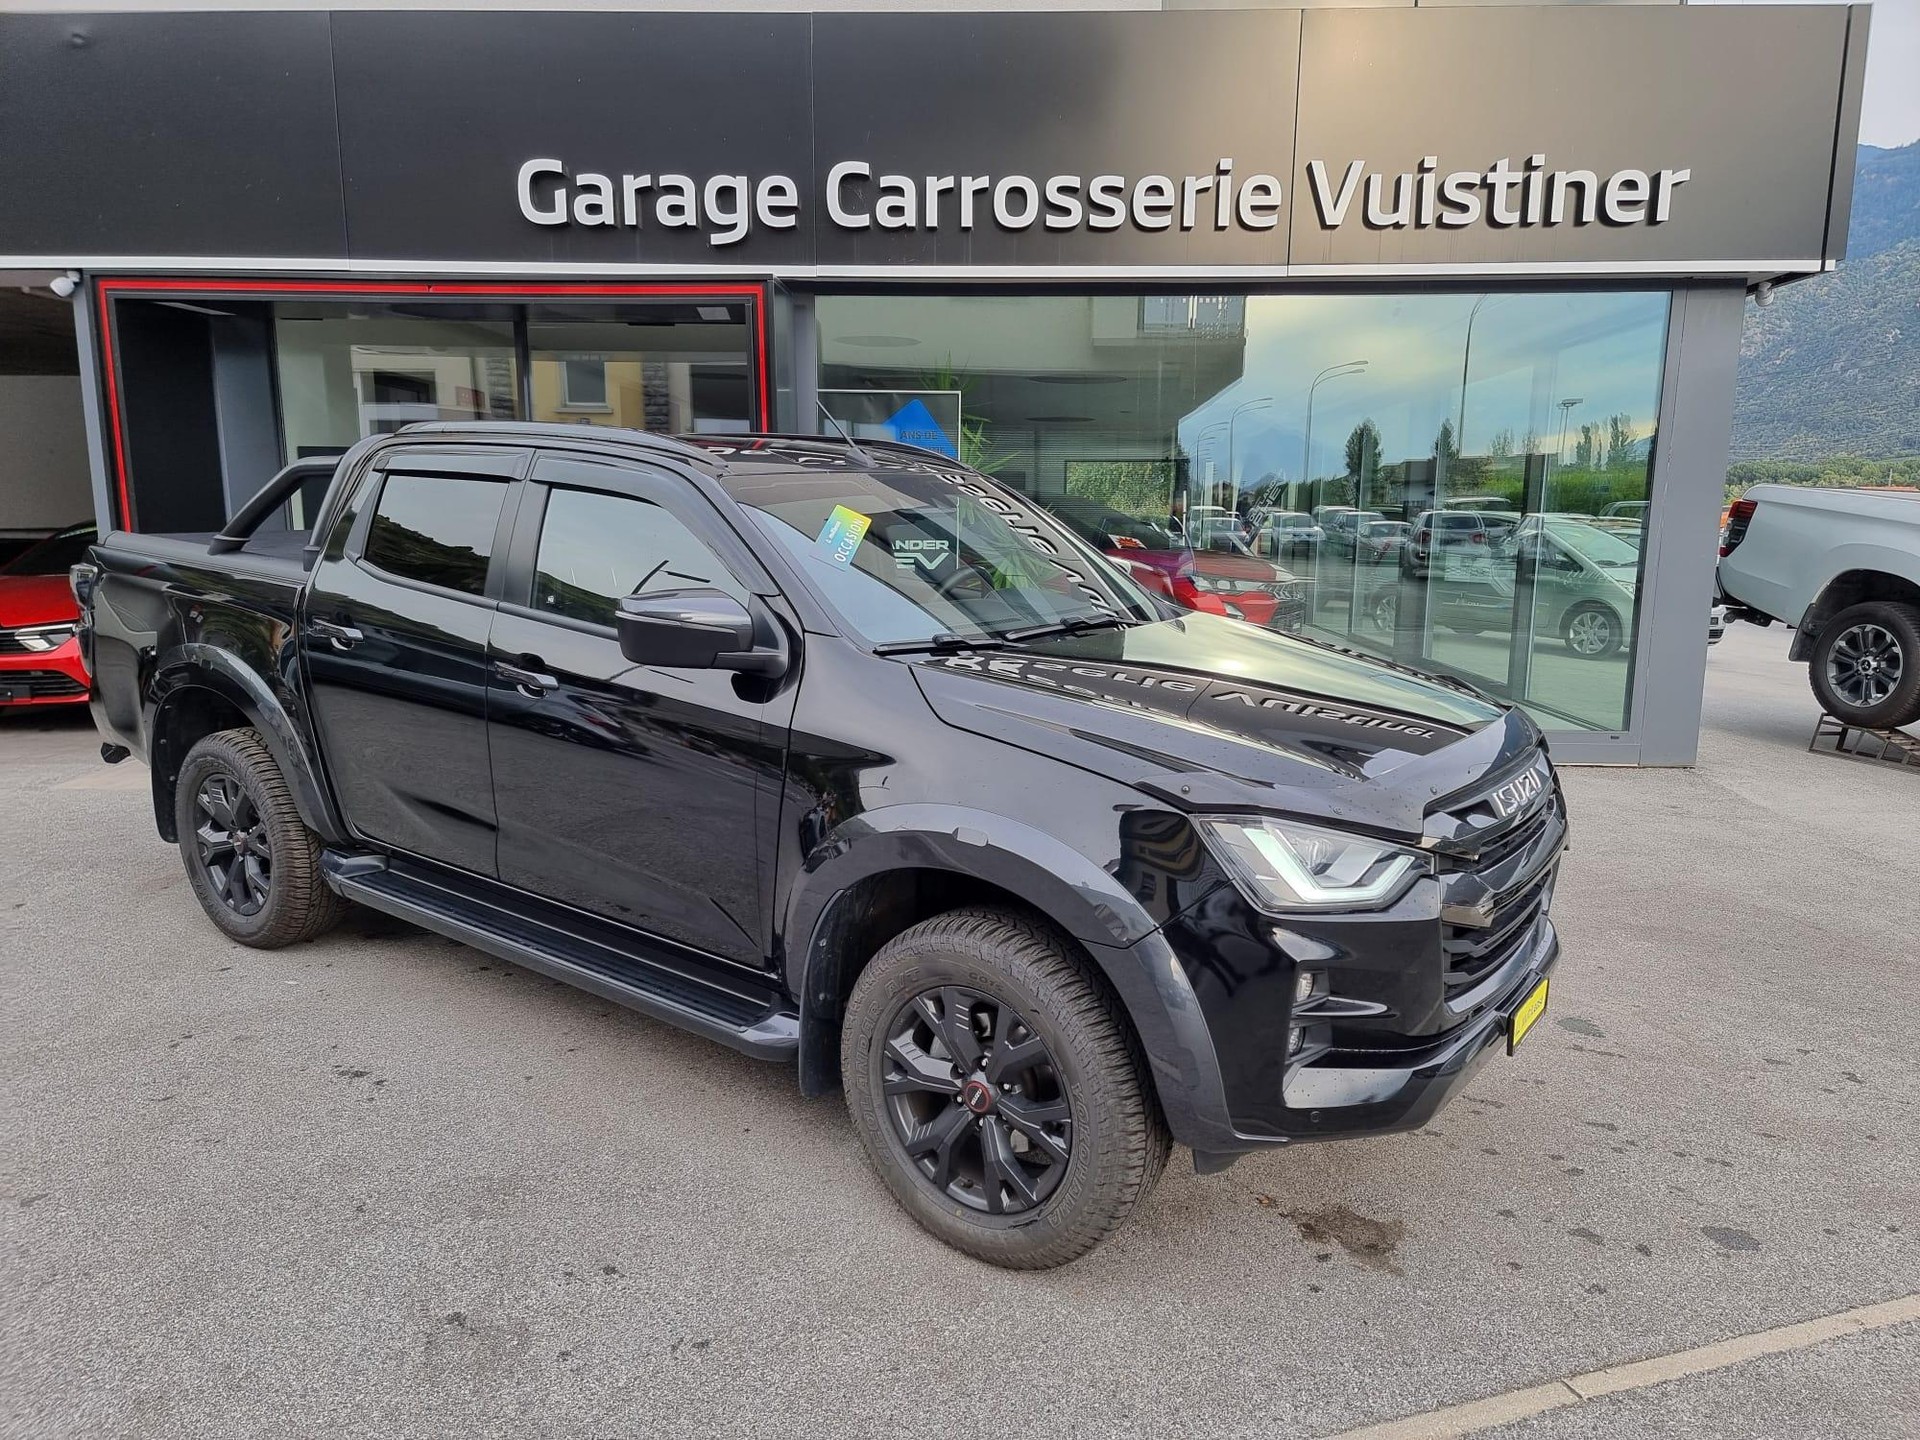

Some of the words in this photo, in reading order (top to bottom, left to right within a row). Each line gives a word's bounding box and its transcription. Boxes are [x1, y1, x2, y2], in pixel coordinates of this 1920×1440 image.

[517, 158, 799, 246] Garage
[826, 157, 1282, 229] Carrosserie
[1306, 154, 1691, 226] Vuistiner
[834, 518, 865, 562] OCCASION
[892, 540, 950, 551] NDER
[1492, 767, 1542, 817] ISUZU
[970, 1088, 983, 1106] ISUZU
[1047, 1083, 1091, 1228] YOKOHAMA
